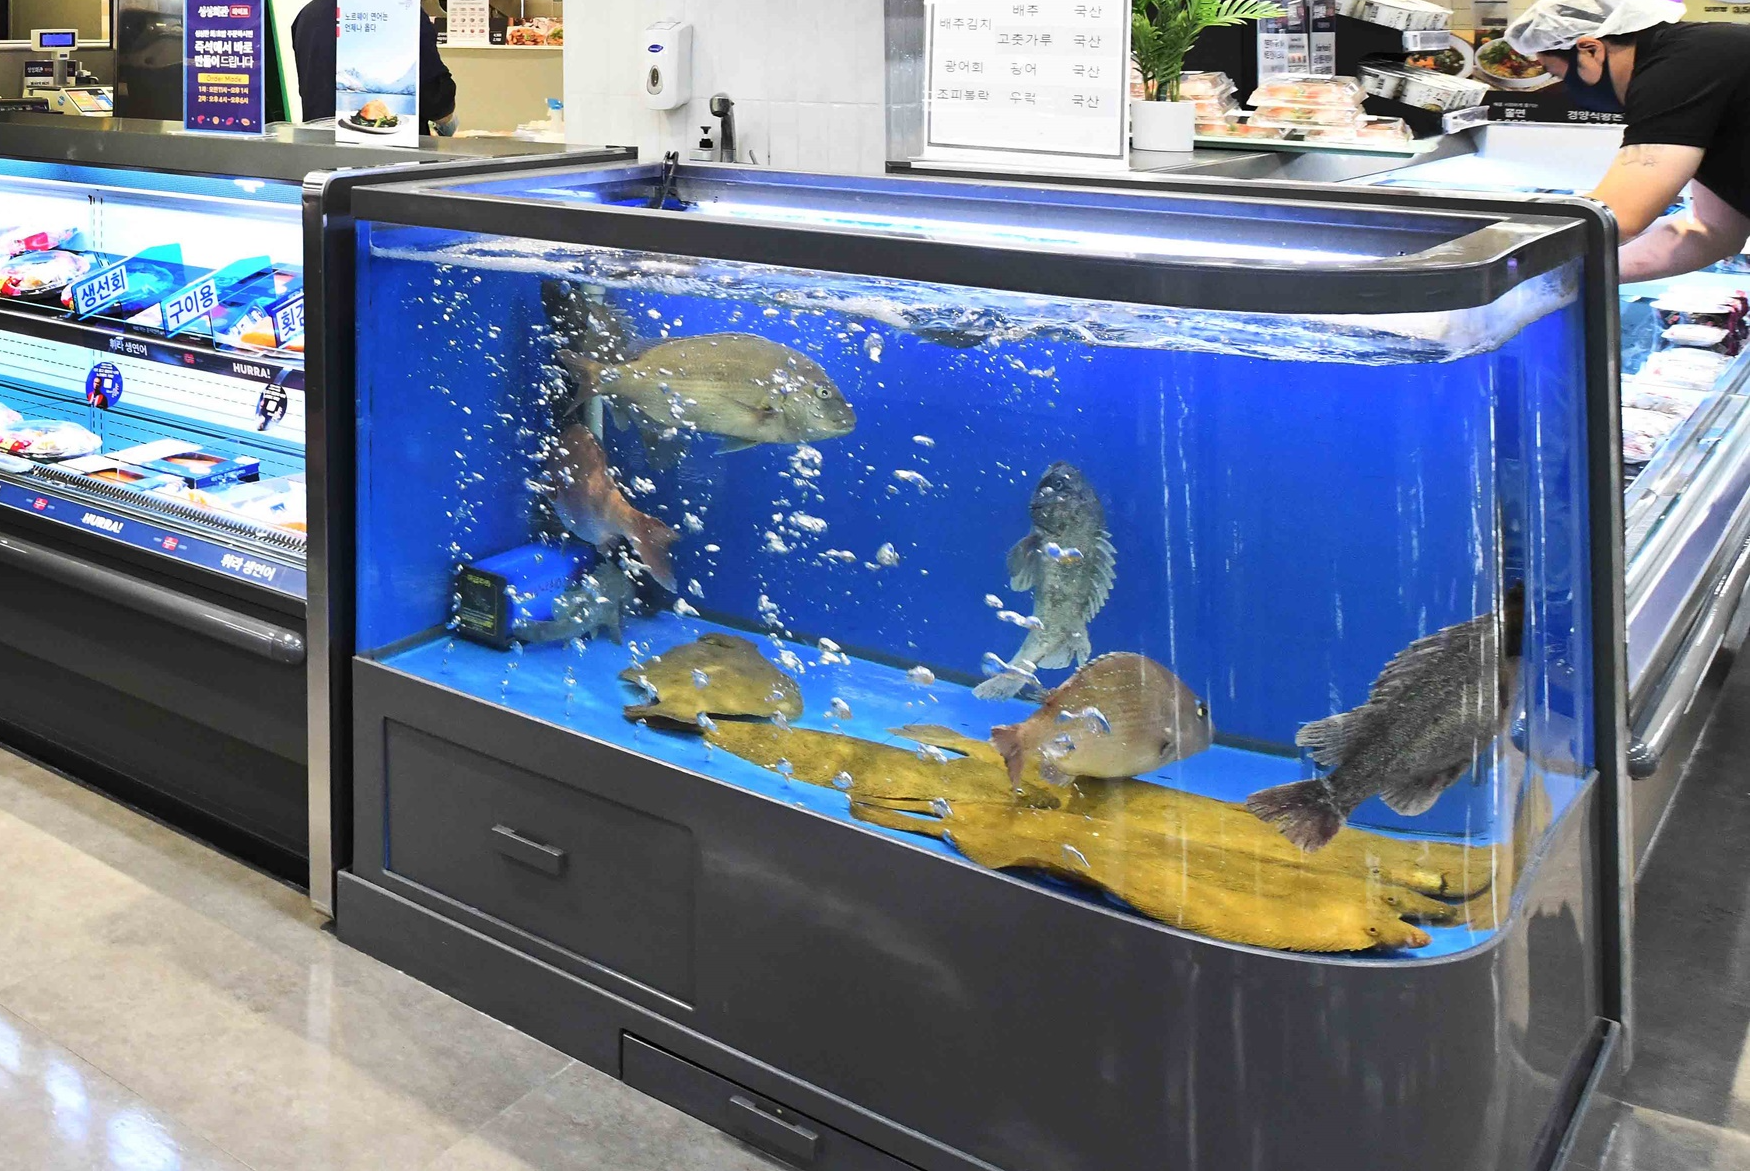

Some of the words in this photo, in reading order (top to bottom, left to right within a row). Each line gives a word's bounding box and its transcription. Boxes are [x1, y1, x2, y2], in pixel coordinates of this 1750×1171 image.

[198, 5, 229, 18] 싱싱회관
[1073, 5, 1103, 19] 국산
[194, 40, 232, 54] 즉석에서
[233, 41, 254, 54] 바로
[1073, 34, 1102, 49] 국산
[194, 55, 220, 68] 만들어
[220, 55, 254, 69] 드립니다
[944, 60, 984, 74] 광어회
[1072, 64, 1100, 79] 국산
[206, 74, 224, 82] Order
[225, 75, 242, 83] Made
[1071, 93, 1100, 109] 국산
[80, 268, 127, 308] 생선회
[168, 283, 215, 325] 구이용
[124, 340, 148, 357] 생연어
[232, 362, 271, 380] HURRA!
[81, 512, 124, 534] HURRA!
[244, 559, 277, 583] 생연어
